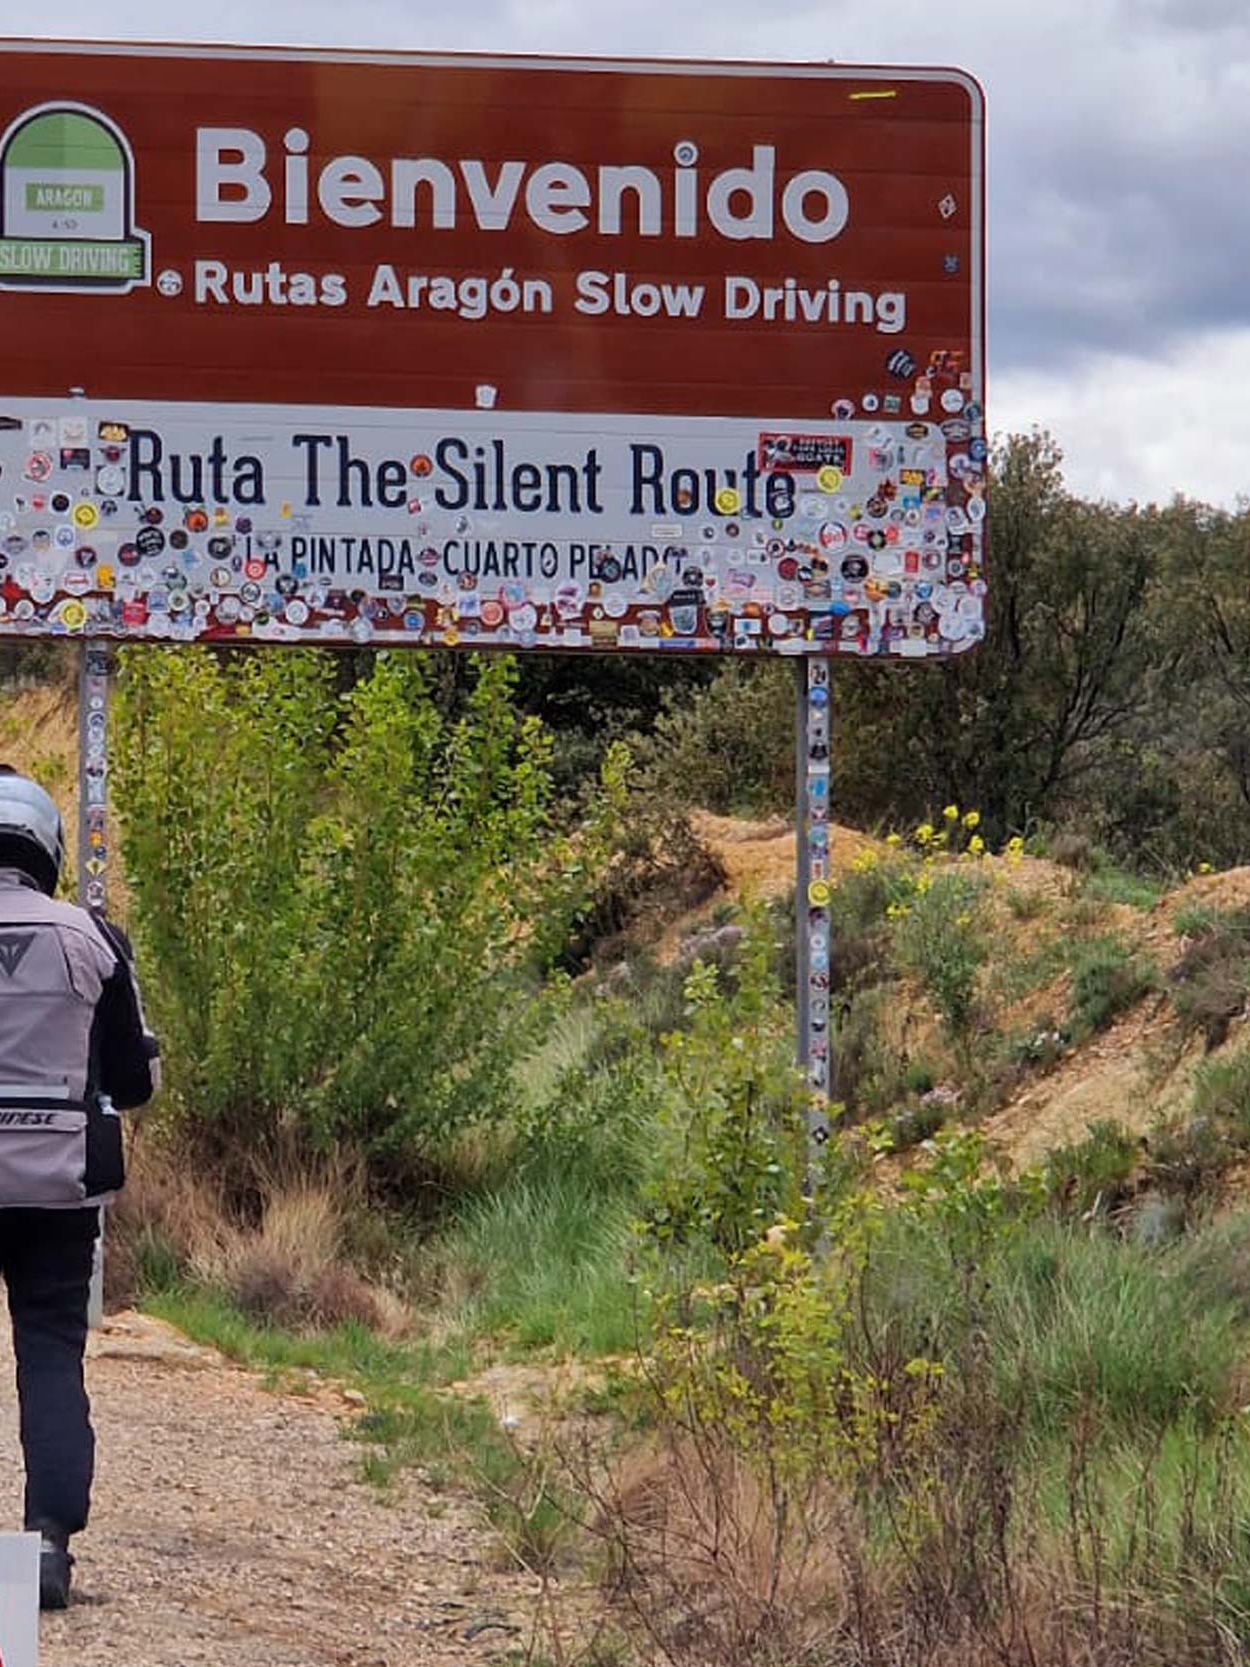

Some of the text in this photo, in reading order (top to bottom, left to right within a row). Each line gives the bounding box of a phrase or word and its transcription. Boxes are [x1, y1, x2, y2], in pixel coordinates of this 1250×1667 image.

[196, 127, 850, 243] Bienvenido
[0, 245, 129, 272] SLOW DRIVING
[195, 260, 906, 334] Rutas Aragón Slow Driving
[128, 429, 796, 519] Ruta The Silent Route
[291, 536, 415, 575] PINTADA
[443, 540, 559, 579] CUARTO
[569, 543, 682, 582] PEAD
